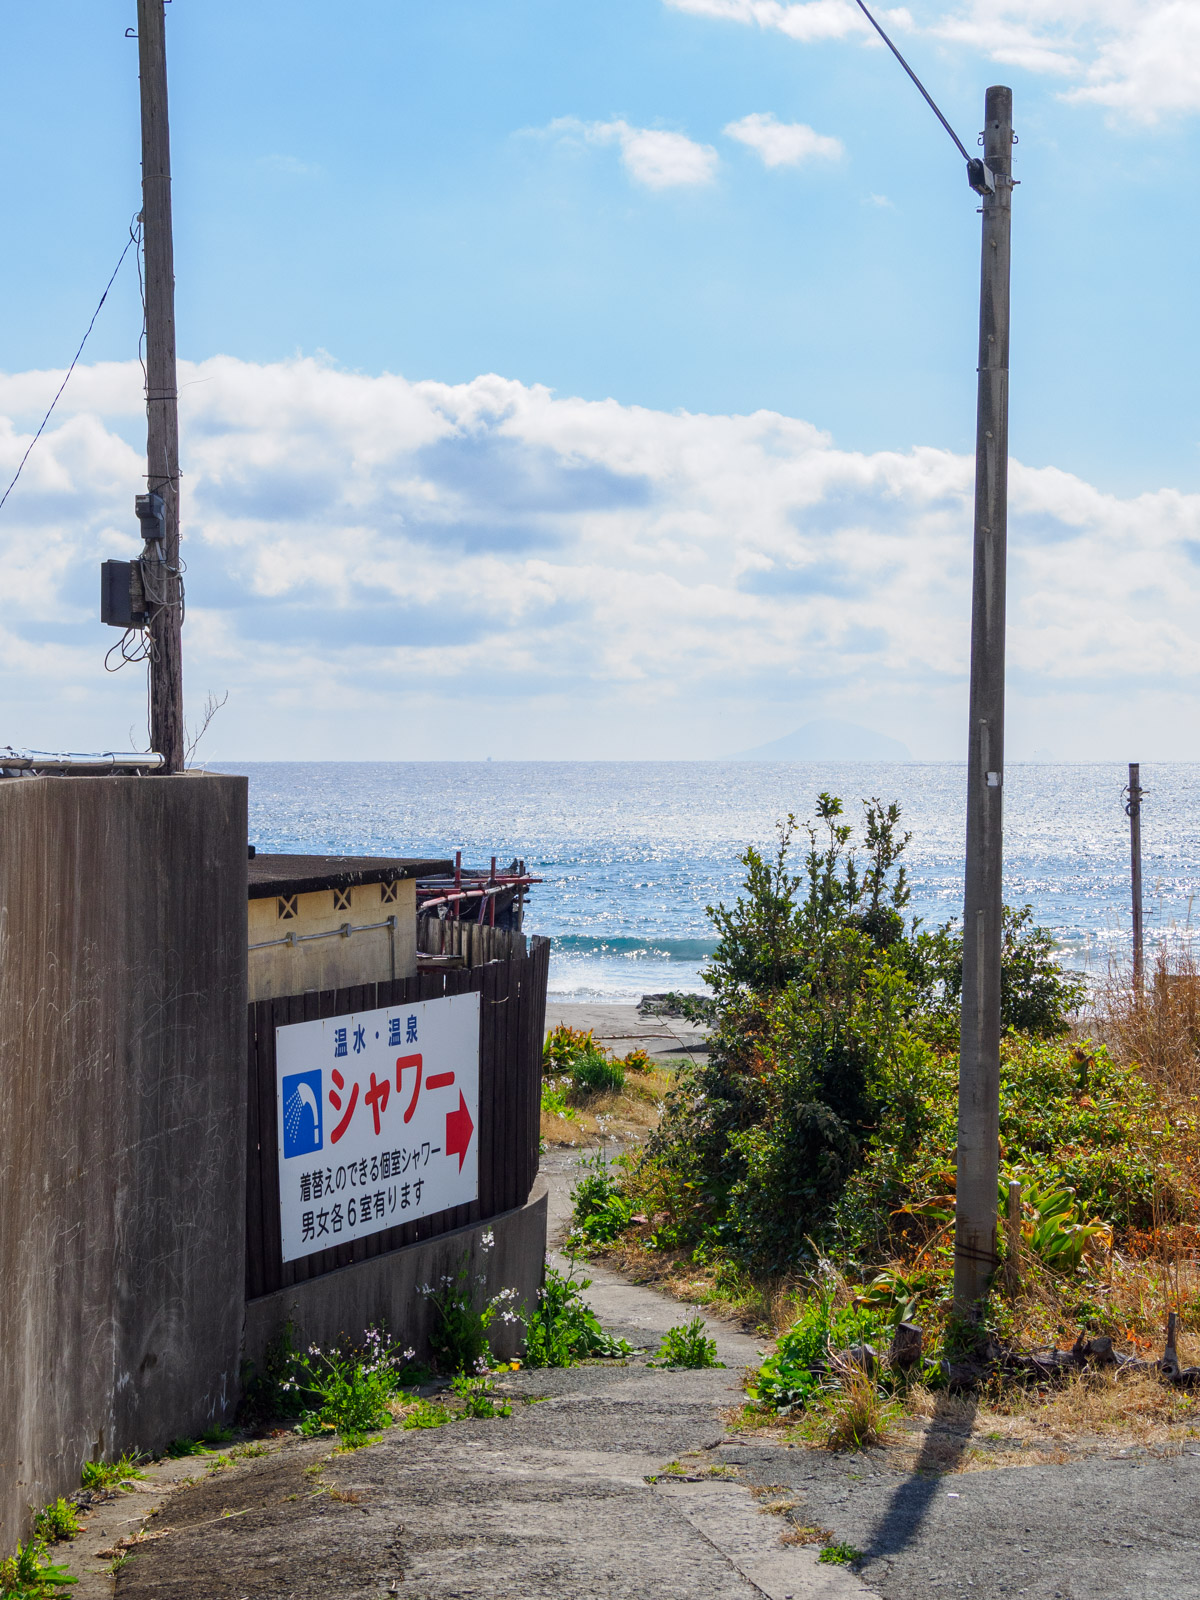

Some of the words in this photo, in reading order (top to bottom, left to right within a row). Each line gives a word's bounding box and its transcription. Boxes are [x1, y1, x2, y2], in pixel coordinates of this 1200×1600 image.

[334, 1014, 418, 1058] 温水・温泉
[328, 1053, 455, 1144] シャワー
[300, 1142, 441, 1202] 着替えのできる個室シャワー
